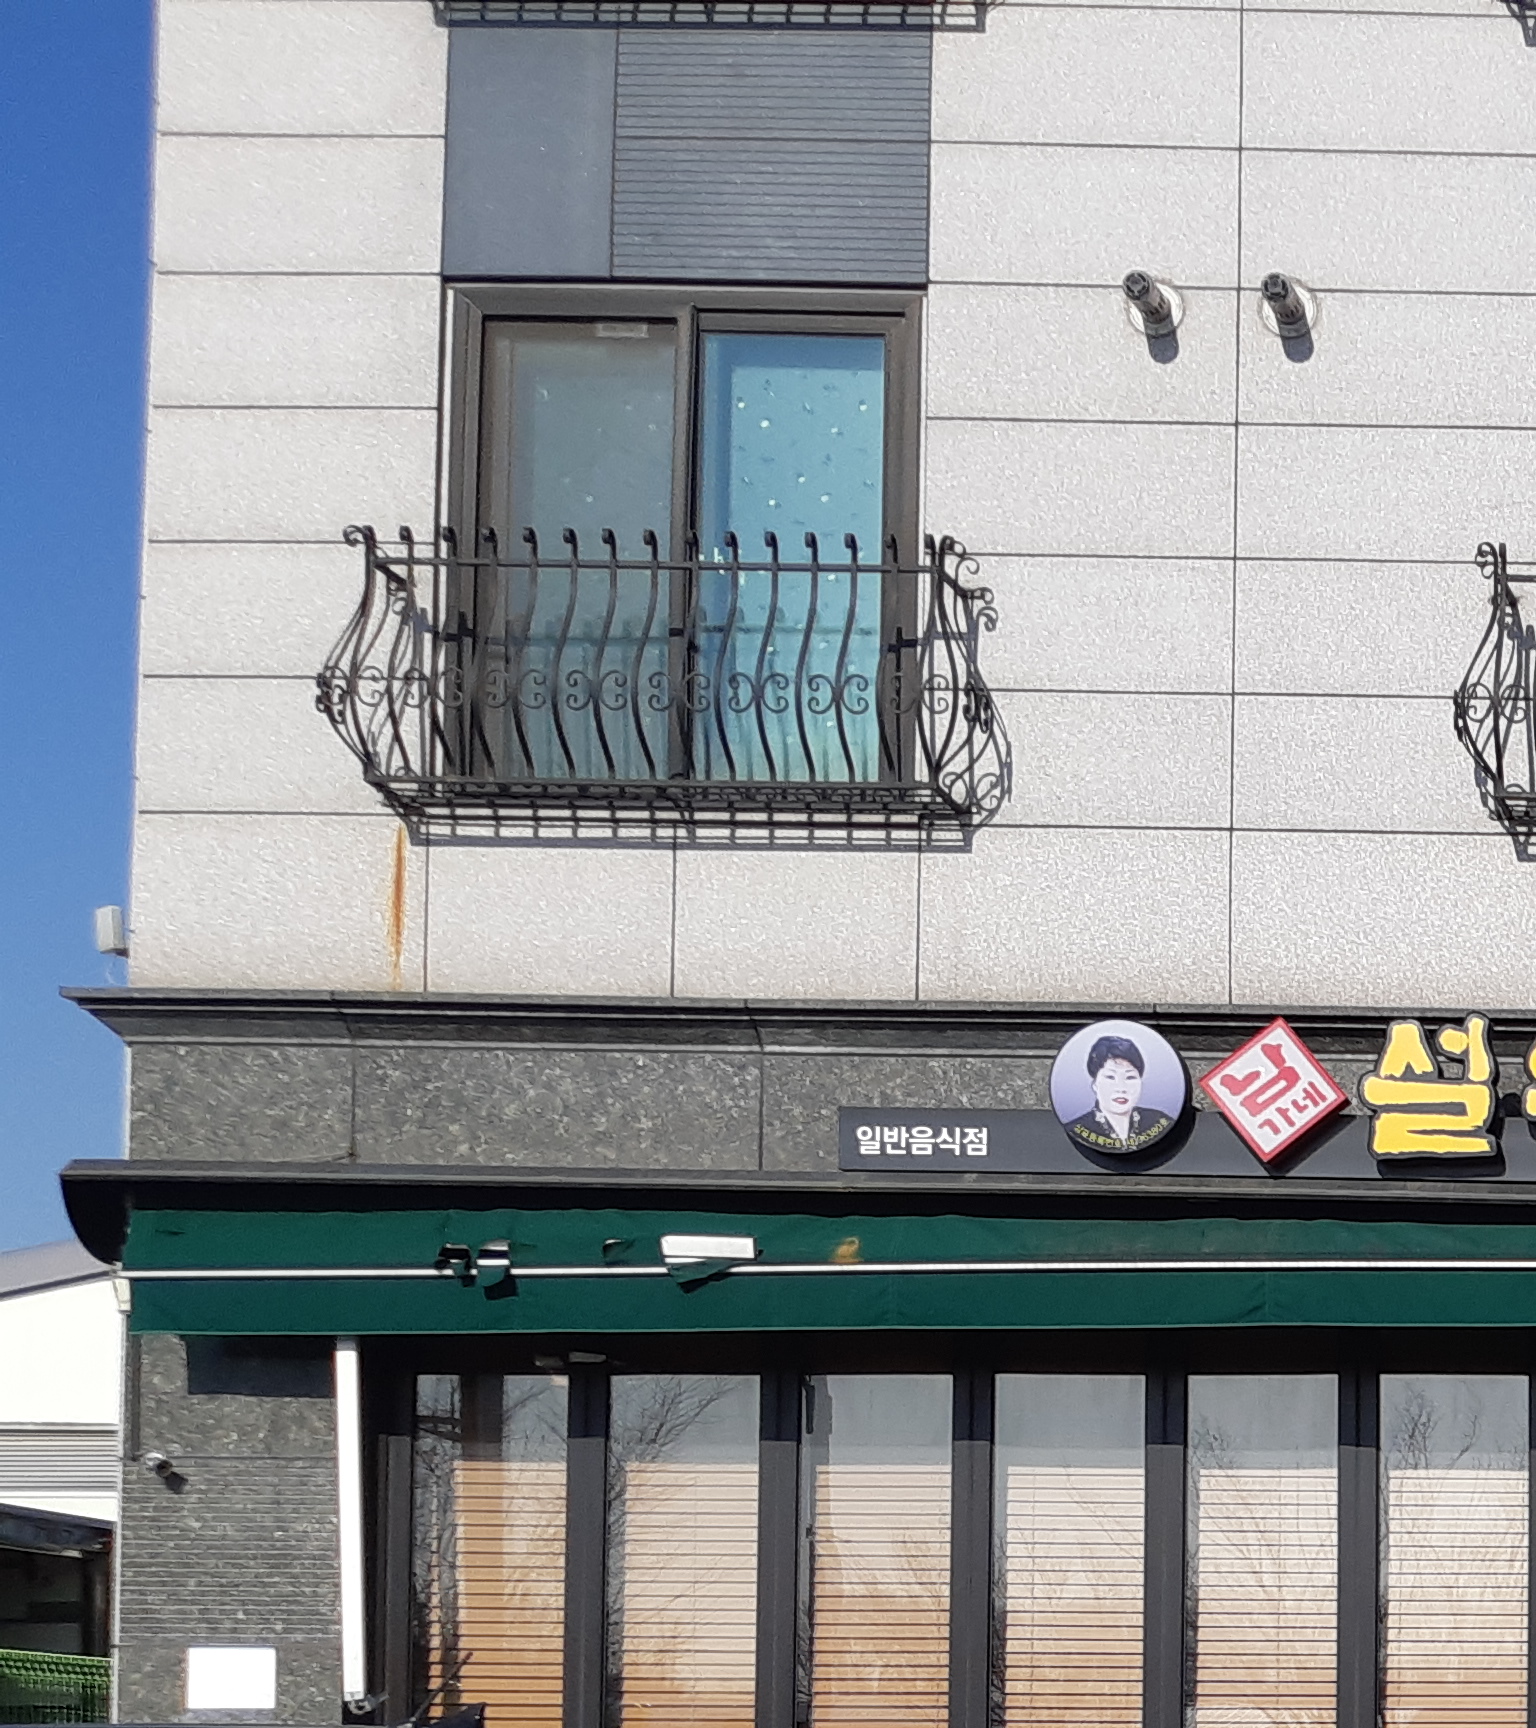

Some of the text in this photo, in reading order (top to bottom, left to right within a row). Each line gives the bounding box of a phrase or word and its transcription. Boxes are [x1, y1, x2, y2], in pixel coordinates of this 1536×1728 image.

[1219, 1042, 1301, 1118] 남
[1257, 1080, 1328, 1136] 가네
[856, 1125, 988, 1156] 일반음식점
